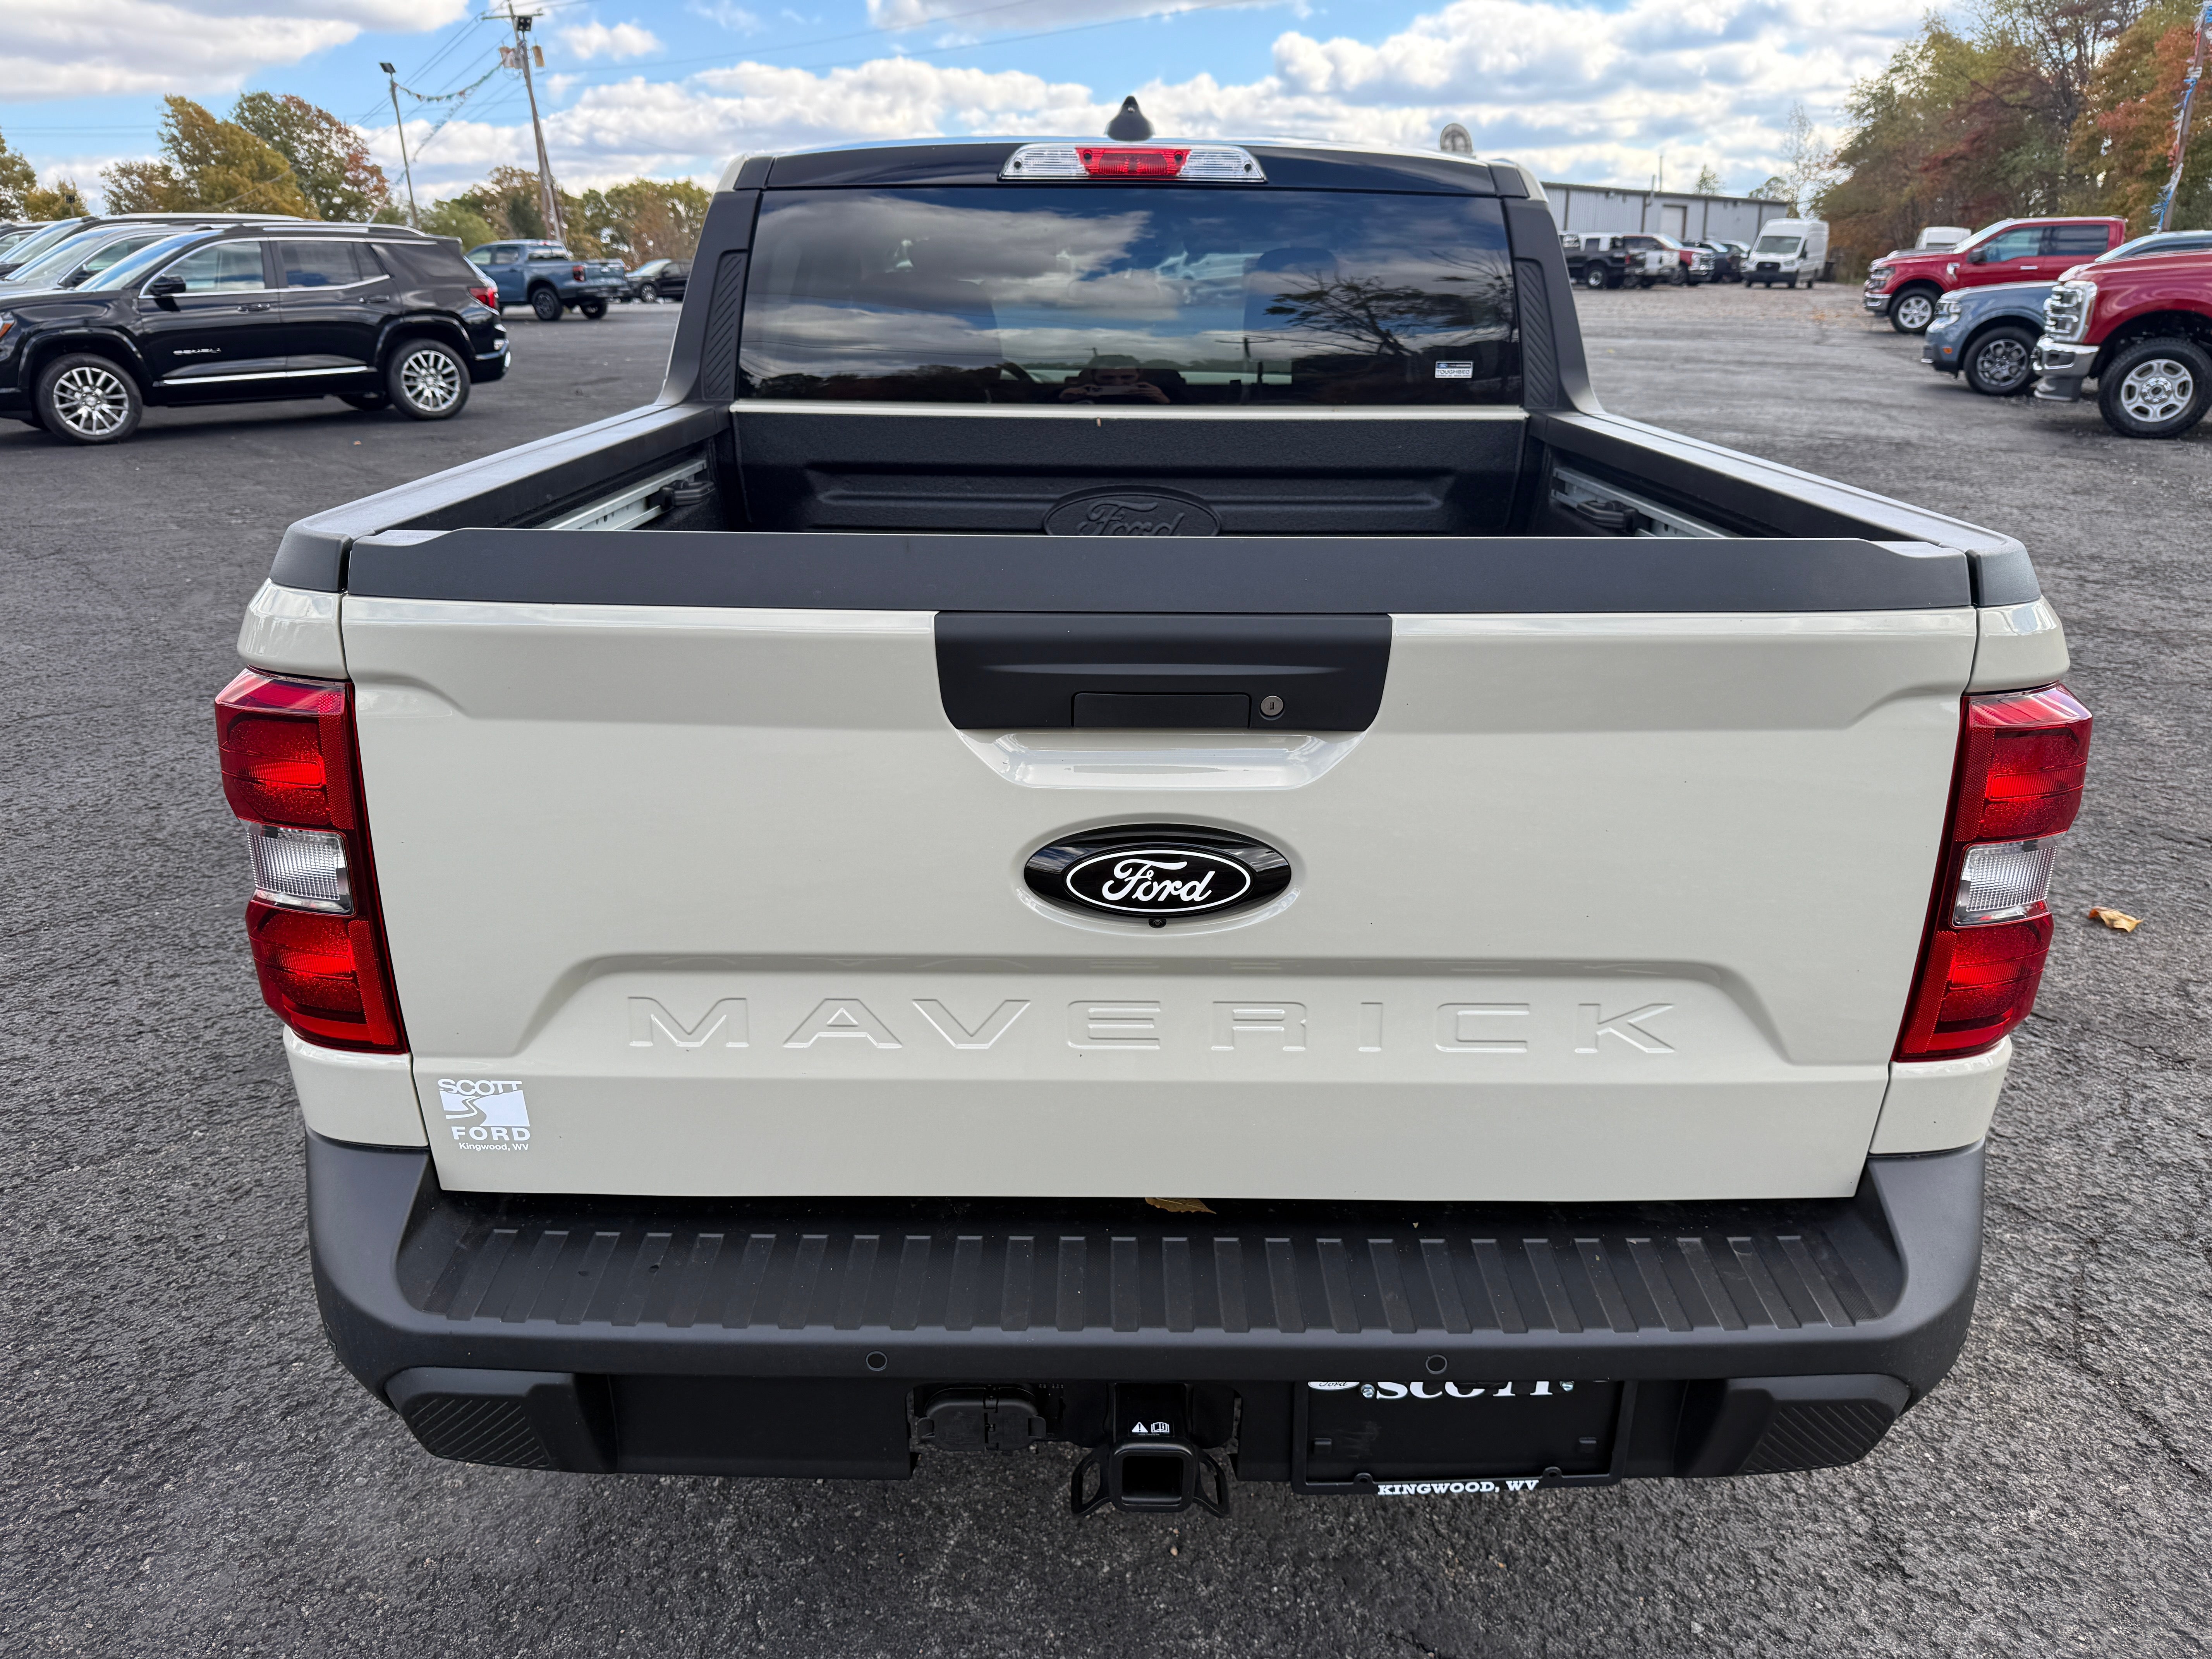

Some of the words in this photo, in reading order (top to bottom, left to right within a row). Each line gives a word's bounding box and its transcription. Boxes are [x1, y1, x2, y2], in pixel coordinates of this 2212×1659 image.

[1076, 500, 1185, 536] Ford
[1102, 859, 1216, 902] Ford
[627, 996, 1675, 1053] MAVERICK
[438, 1079, 522, 1096] SCOTT
[451, 1126, 530, 1141] FORD
[459, 1142, 510, 1151] Kingwood,
[1377, 1482, 1500, 1495] KINGWOOD,
[1506, 1480, 1539, 1491] WV
